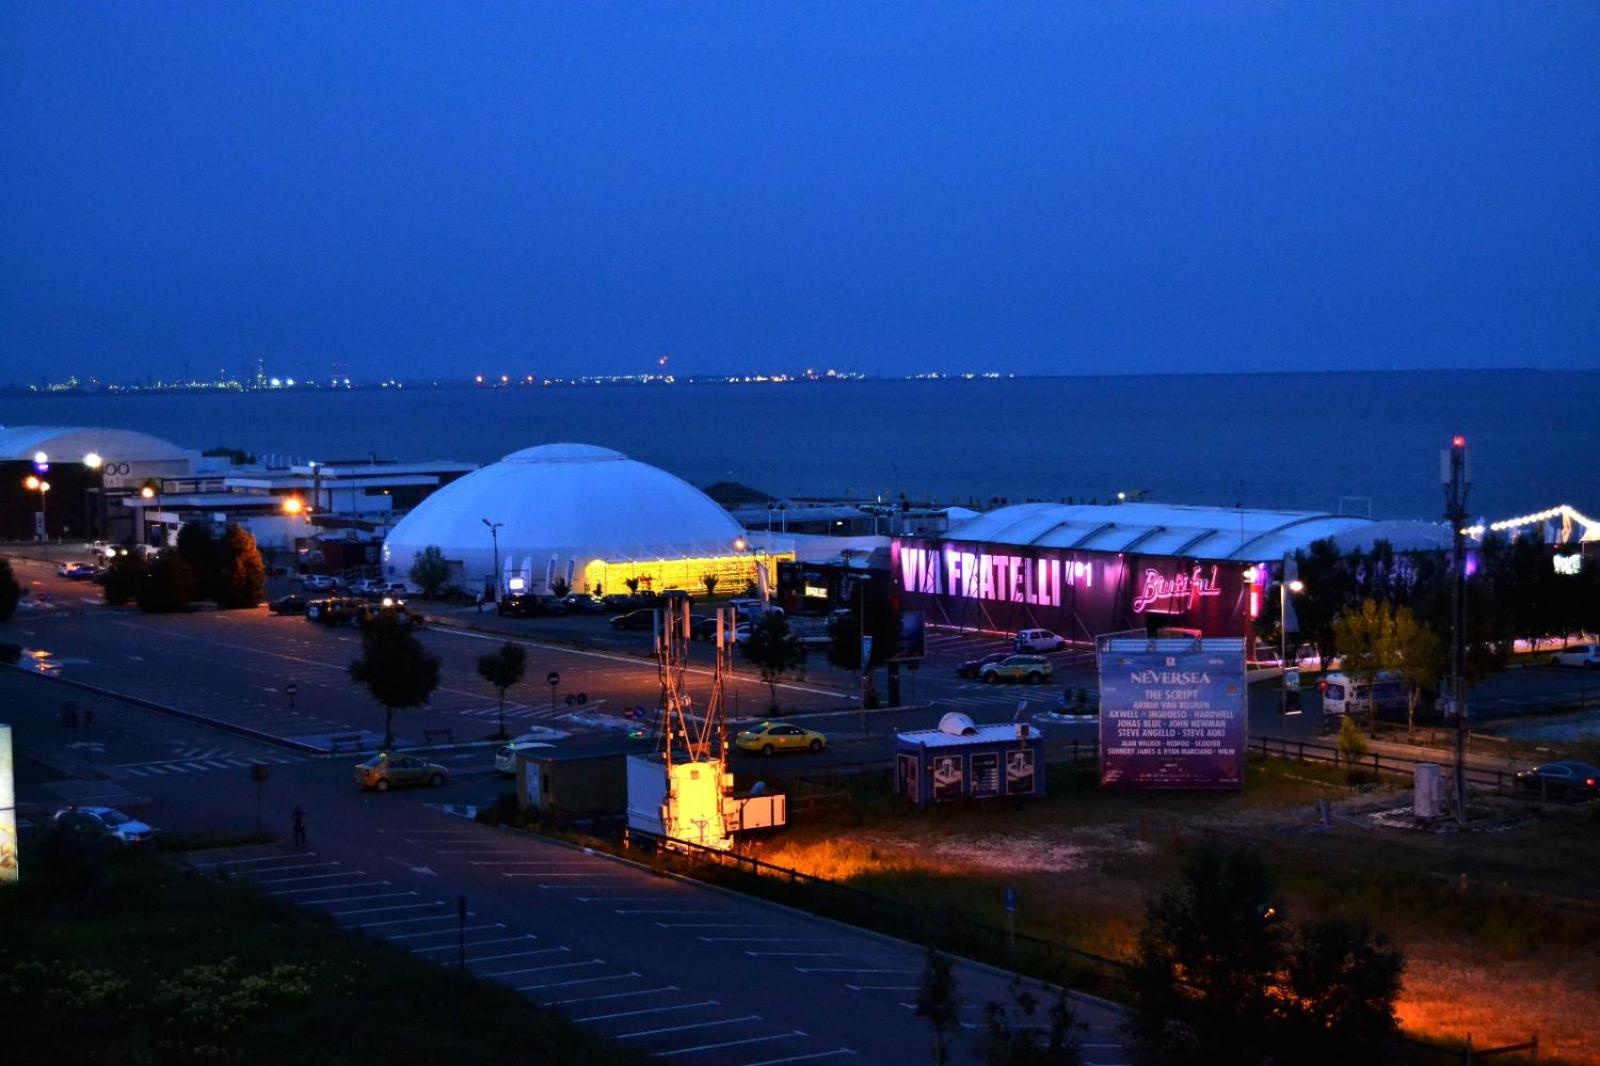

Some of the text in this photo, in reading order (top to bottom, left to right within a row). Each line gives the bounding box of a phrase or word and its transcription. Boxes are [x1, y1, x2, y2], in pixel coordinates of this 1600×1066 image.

[901, 547, 942, 594] VIA
[946, 549, 1061, 607] FRATELLI
[1131, 669, 1211, 685] NEVERSEA
[1145, 690, 1198, 700] THE SCRIPT
[1161, 701, 1178, 709] VAN
[1109, 710, 1138, 718] AXWELL
[1194, 710, 1234, 718] HARDWELL
[1117, 720, 1226, 728] JONAS BLUE JOHN NEWMAN
[1118, 729, 1225, 737] STEVE ANGELLO STEVE AOKI
